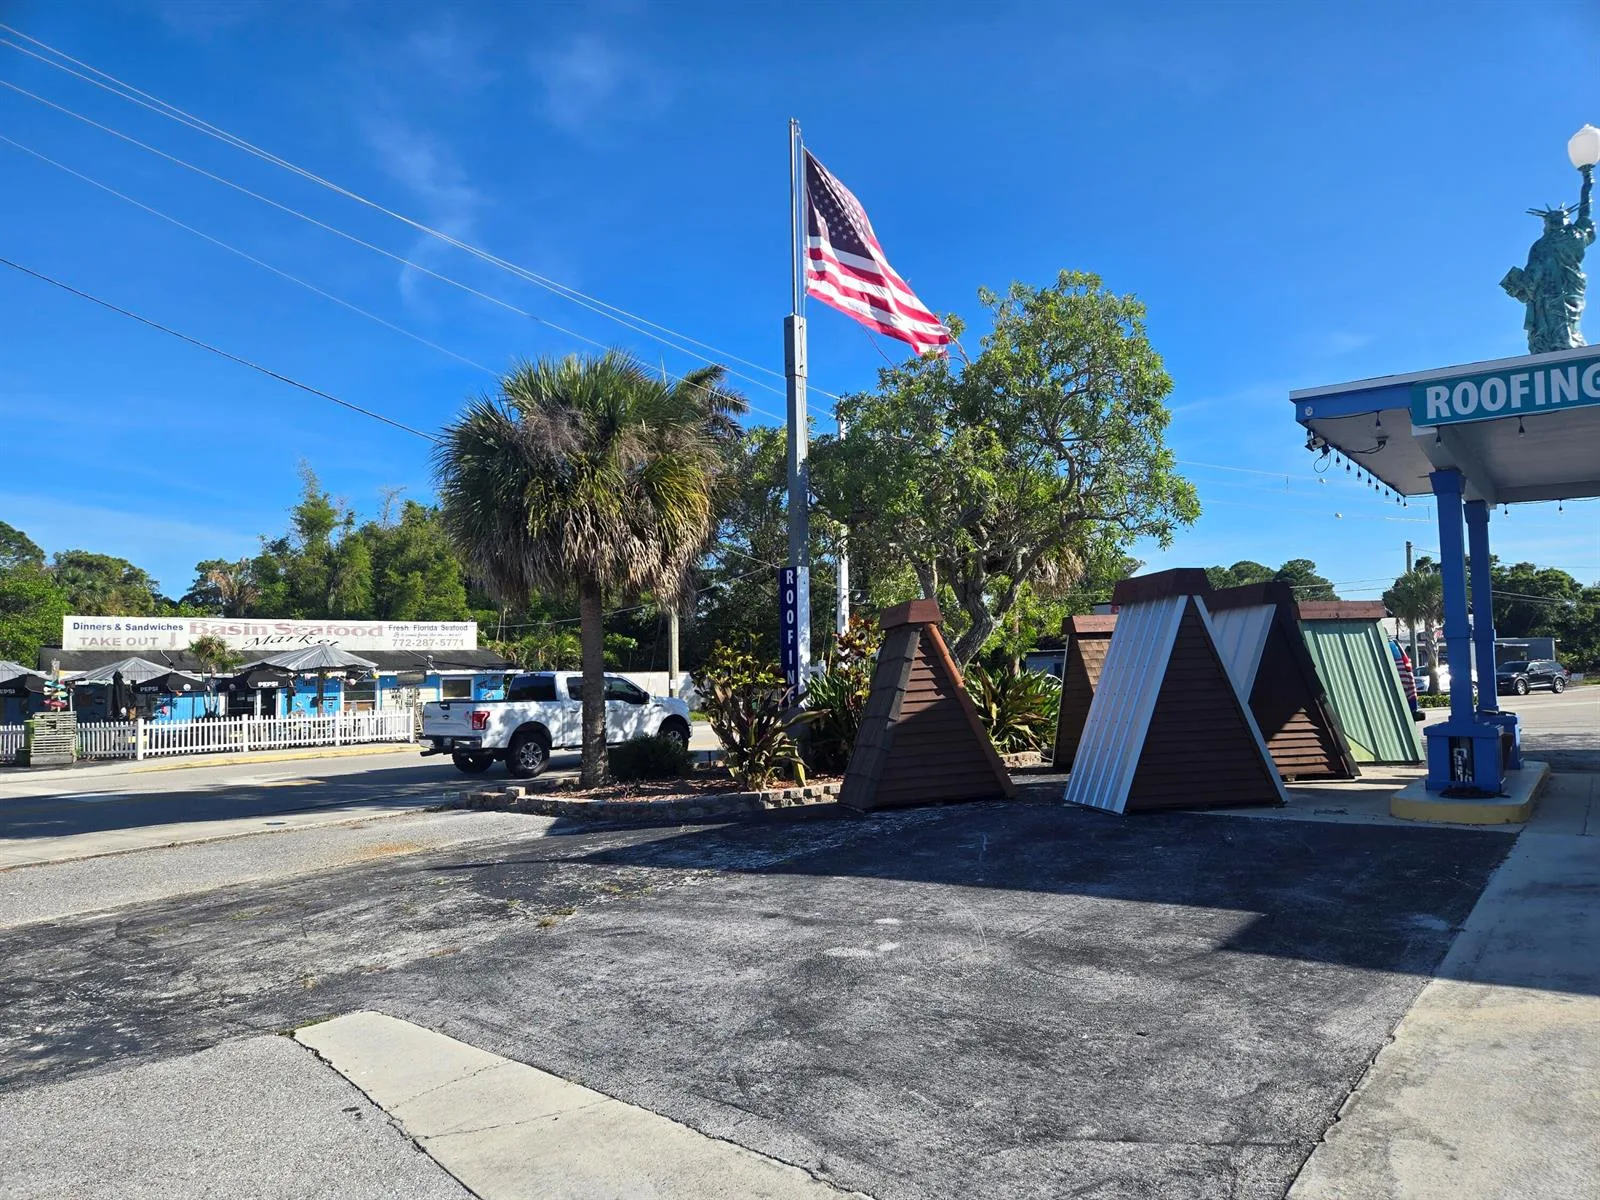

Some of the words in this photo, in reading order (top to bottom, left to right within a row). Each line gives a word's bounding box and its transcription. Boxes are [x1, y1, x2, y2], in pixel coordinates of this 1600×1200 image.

[1426, 362, 1600, 419] ROOFING
[73, 622, 112, 631] Dinners
[114, 623, 122, 631] &
[125, 623, 184, 631] Sandwiches
[189, 622, 268, 636] Basin
[274, 623, 383, 637] Seafood
[79, 637, 121, 646] TAKE
[126, 637, 159, 646] OUT
[392, 638, 464, 647] 772-287-5771
